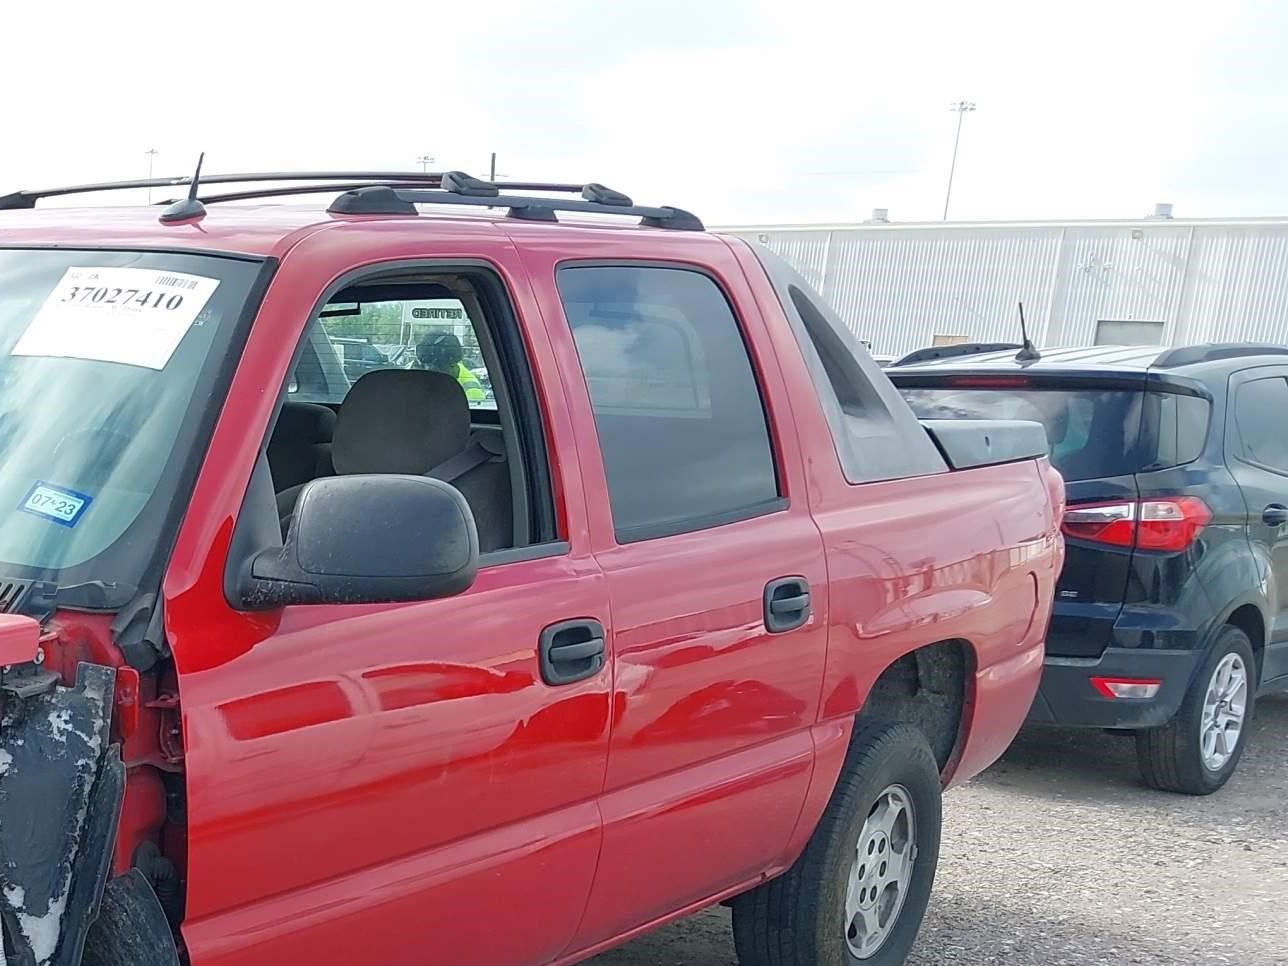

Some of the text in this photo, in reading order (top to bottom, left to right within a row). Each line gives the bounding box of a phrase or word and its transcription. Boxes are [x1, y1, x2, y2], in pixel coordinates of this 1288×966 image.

[61, 286, 184, 311] 37027410
[31, 493, 77, 516] 07 23
